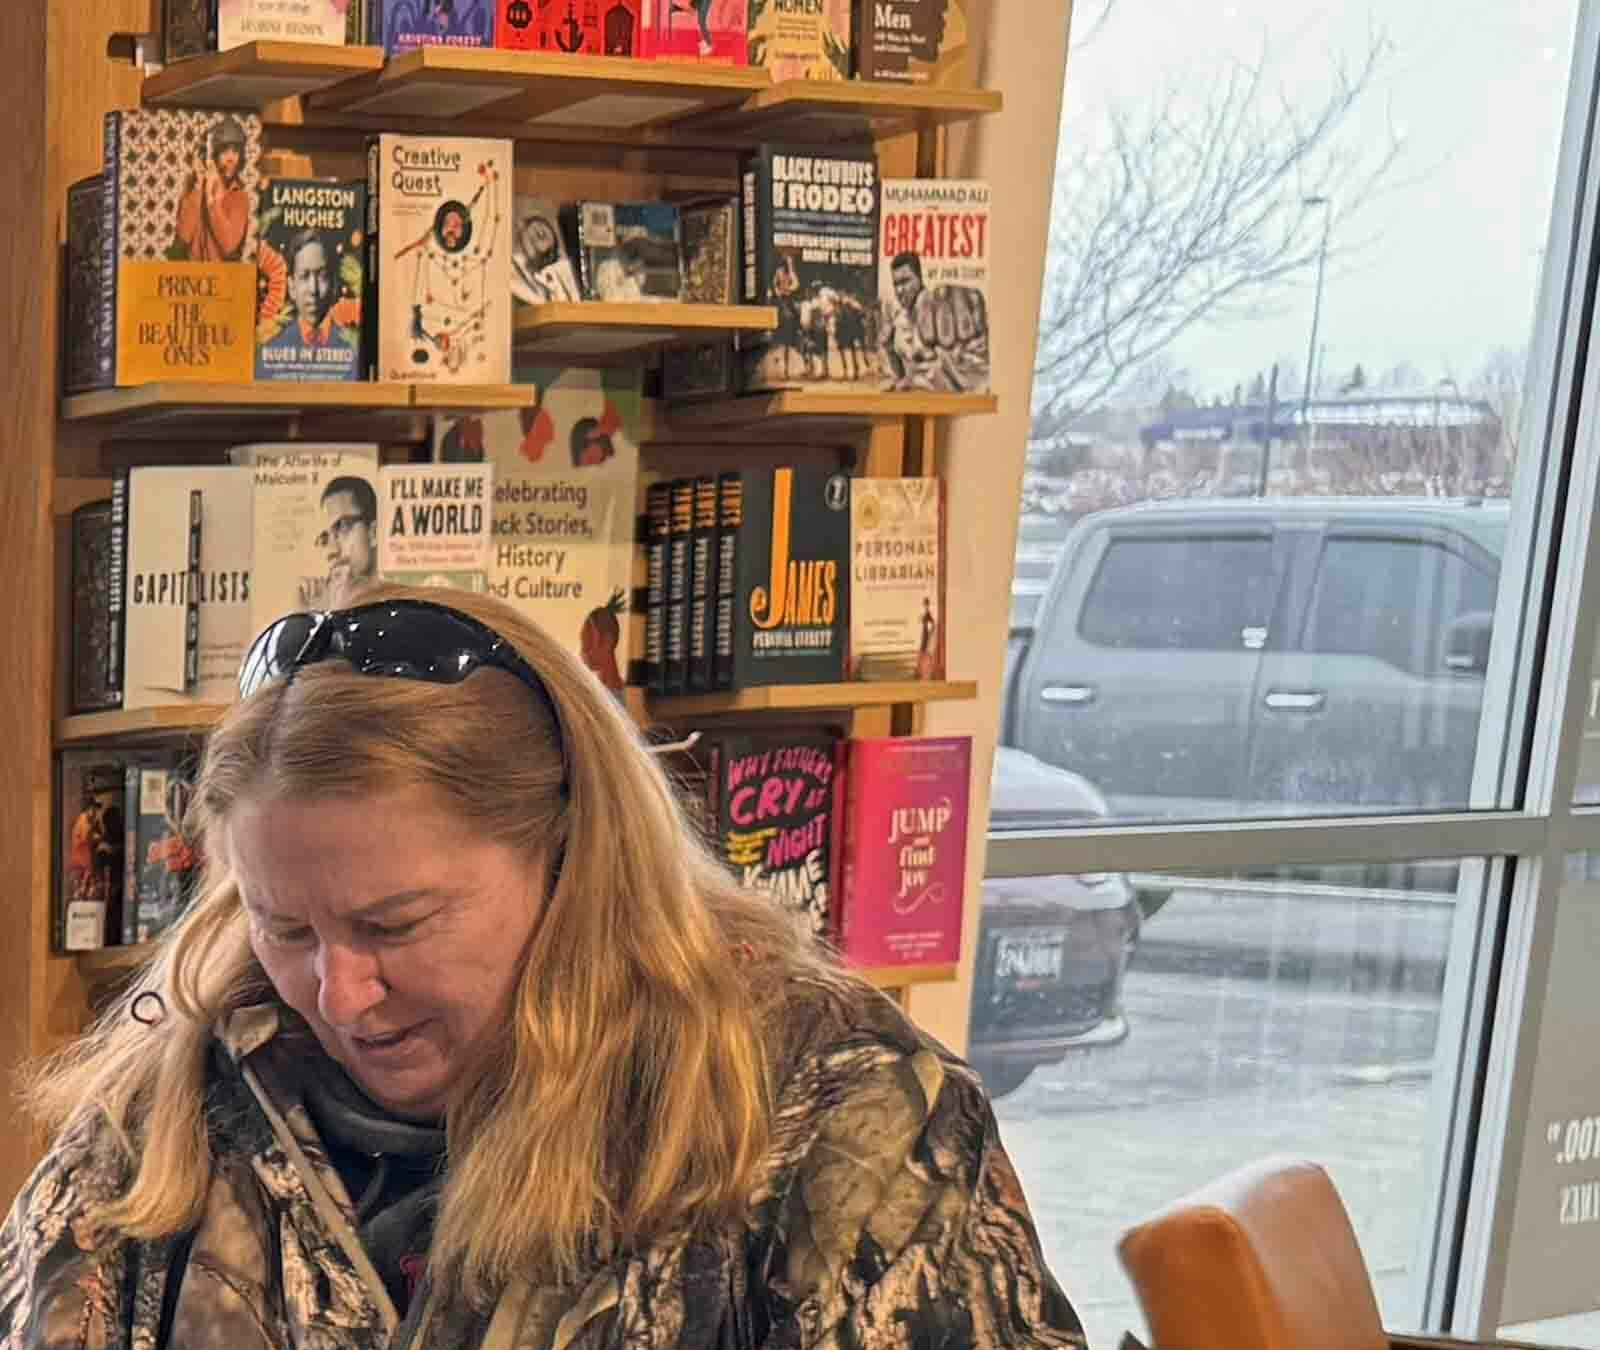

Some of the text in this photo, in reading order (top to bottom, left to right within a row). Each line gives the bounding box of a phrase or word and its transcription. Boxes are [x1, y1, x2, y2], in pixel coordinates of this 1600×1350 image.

[875, 4, 912, 29] Men
[391, 145, 462, 171] Creative
[772, 155, 874, 186] BLACK COWBOYS
[391, 171, 441, 194] Quest
[885, 187, 990, 203] MUHAMMAD ALI
[273, 184, 355, 208] LANGSTON
[787, 182, 875, 214] RODEO
[283, 208, 345, 230] HUGHES
[884, 214, 988, 258] GREATEST
[158, 274, 219, 297] PRINCE
[138, 321, 238, 346] BEAUTIFUL
[162, 346, 210, 367] ONES
[421, 477, 485, 499] MAKE ME
[491, 481, 588, 509] elebrating
[390, 503, 485, 538] A WORLD
[526, 512, 594, 538] Stories,
[750, 467, 838, 630] JAMES
[855, 540, 936, 556] PERSONAL
[497, 546, 566, 577] History
[855, 566, 936, 583] LIBRARIAN
[517, 578, 583, 599] Culture
[727, 752, 769, 792] WHY
[729, 777, 804, 826] CRY
[888, 797, 952, 845] JUMP
[767, 813, 827, 867] NIGHT
